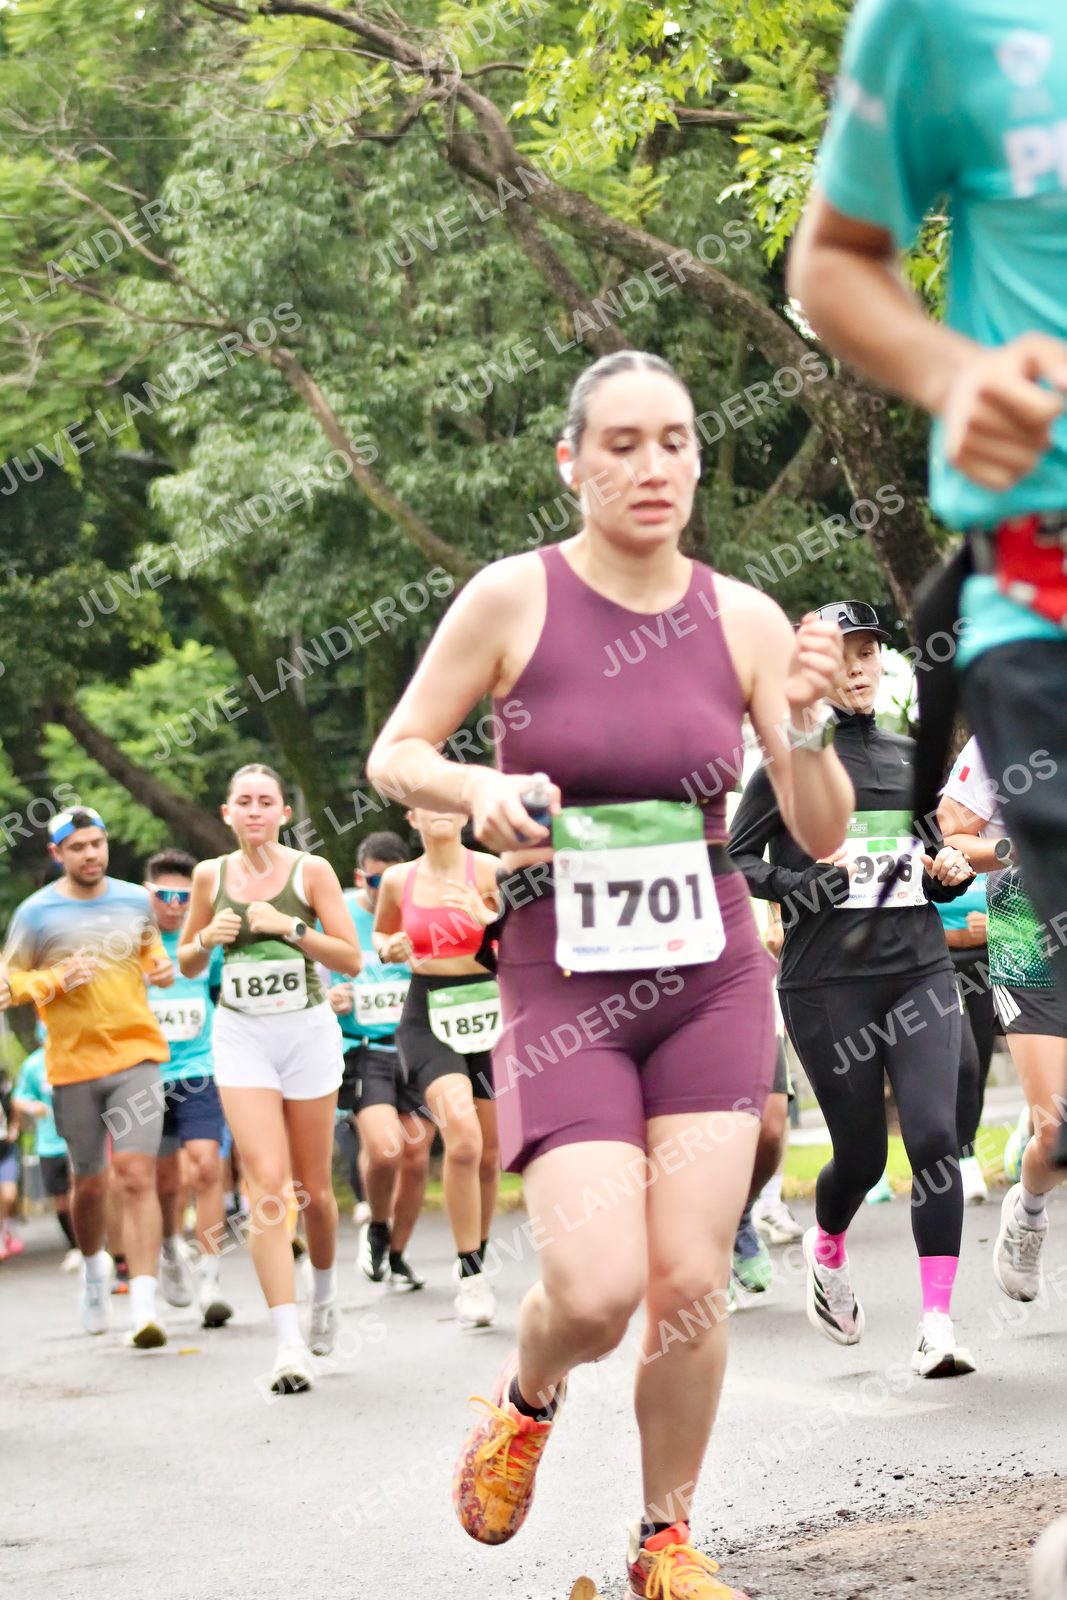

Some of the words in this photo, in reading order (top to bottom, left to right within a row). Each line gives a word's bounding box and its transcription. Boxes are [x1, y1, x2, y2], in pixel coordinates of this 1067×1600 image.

[854, 853, 912, 884] 926
[573, 873, 703, 929] 1701
[231, 972, 300, 999] 1826
[440, 1011, 499, 1038] 1857
